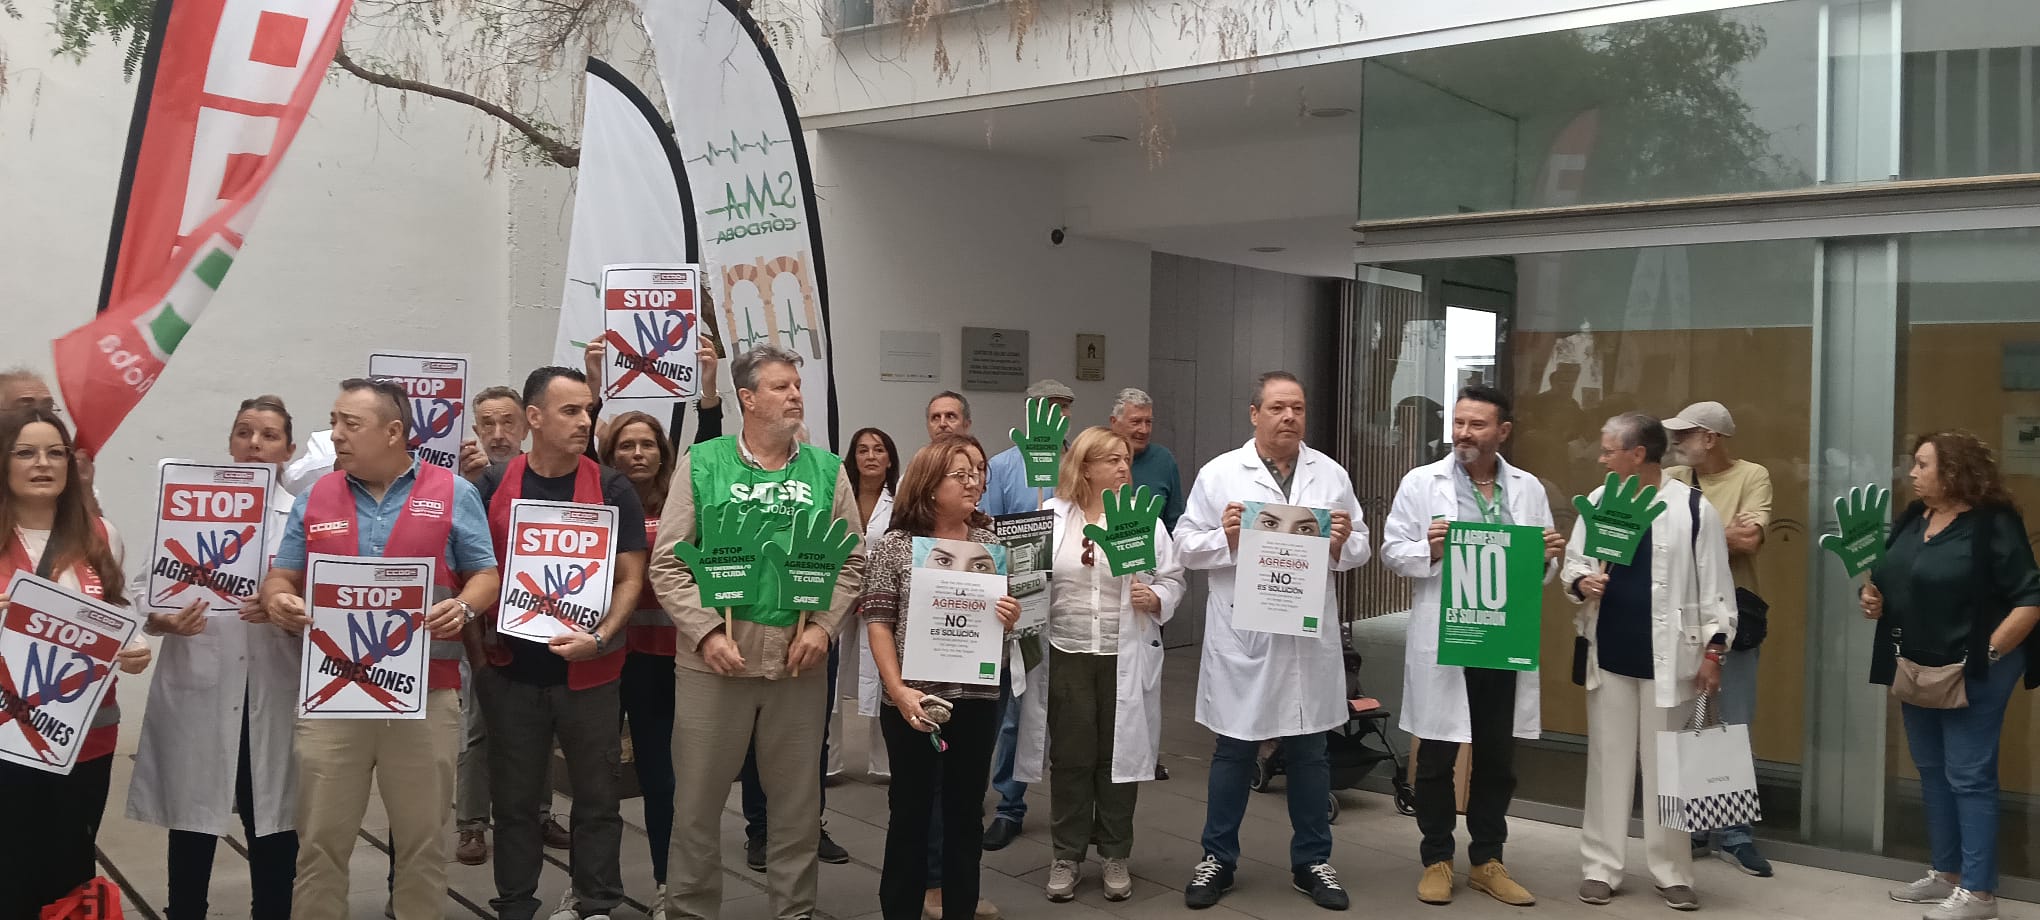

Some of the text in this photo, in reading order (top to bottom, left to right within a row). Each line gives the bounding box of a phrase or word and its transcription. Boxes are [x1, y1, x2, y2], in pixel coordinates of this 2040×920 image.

[623, 289, 677, 308] STOP
[633, 309, 689, 358] NO
[730, 480, 814, 506] SATSE
[170, 489, 255, 518] STOP
[997, 521, 1053, 536] RECOMENDADO
[1451, 528, 1463, 544] LA
[521, 527, 599, 554] STOP
[196, 529, 241, 569] NO
[712, 546, 742, 555] #STOP
[798, 552, 825, 560] #STOP
[699, 555, 756, 565] AGRESIONES
[784, 561, 836, 570] AGRESIONES
[544, 563, 587, 598] NO
[722, 570, 746, 578] CUIDA
[1270, 572, 1292, 585] NO
[1451, 543, 1508, 610] NO
[955, 589, 967, 597] LA
[1010, 578, 1041, 593] ESPETO
[336, 586, 402, 608] STOP
[714, 591, 744, 600] SATSE
[792, 595, 820, 604] SATSE
[944, 614, 967, 628] NO
[1446, 607, 1459, 623] ES
[25, 612, 98, 648] STOP
[347, 609, 414, 663] NO
[930, 628, 940, 636] ES
[21, 641, 95, 705] NO
